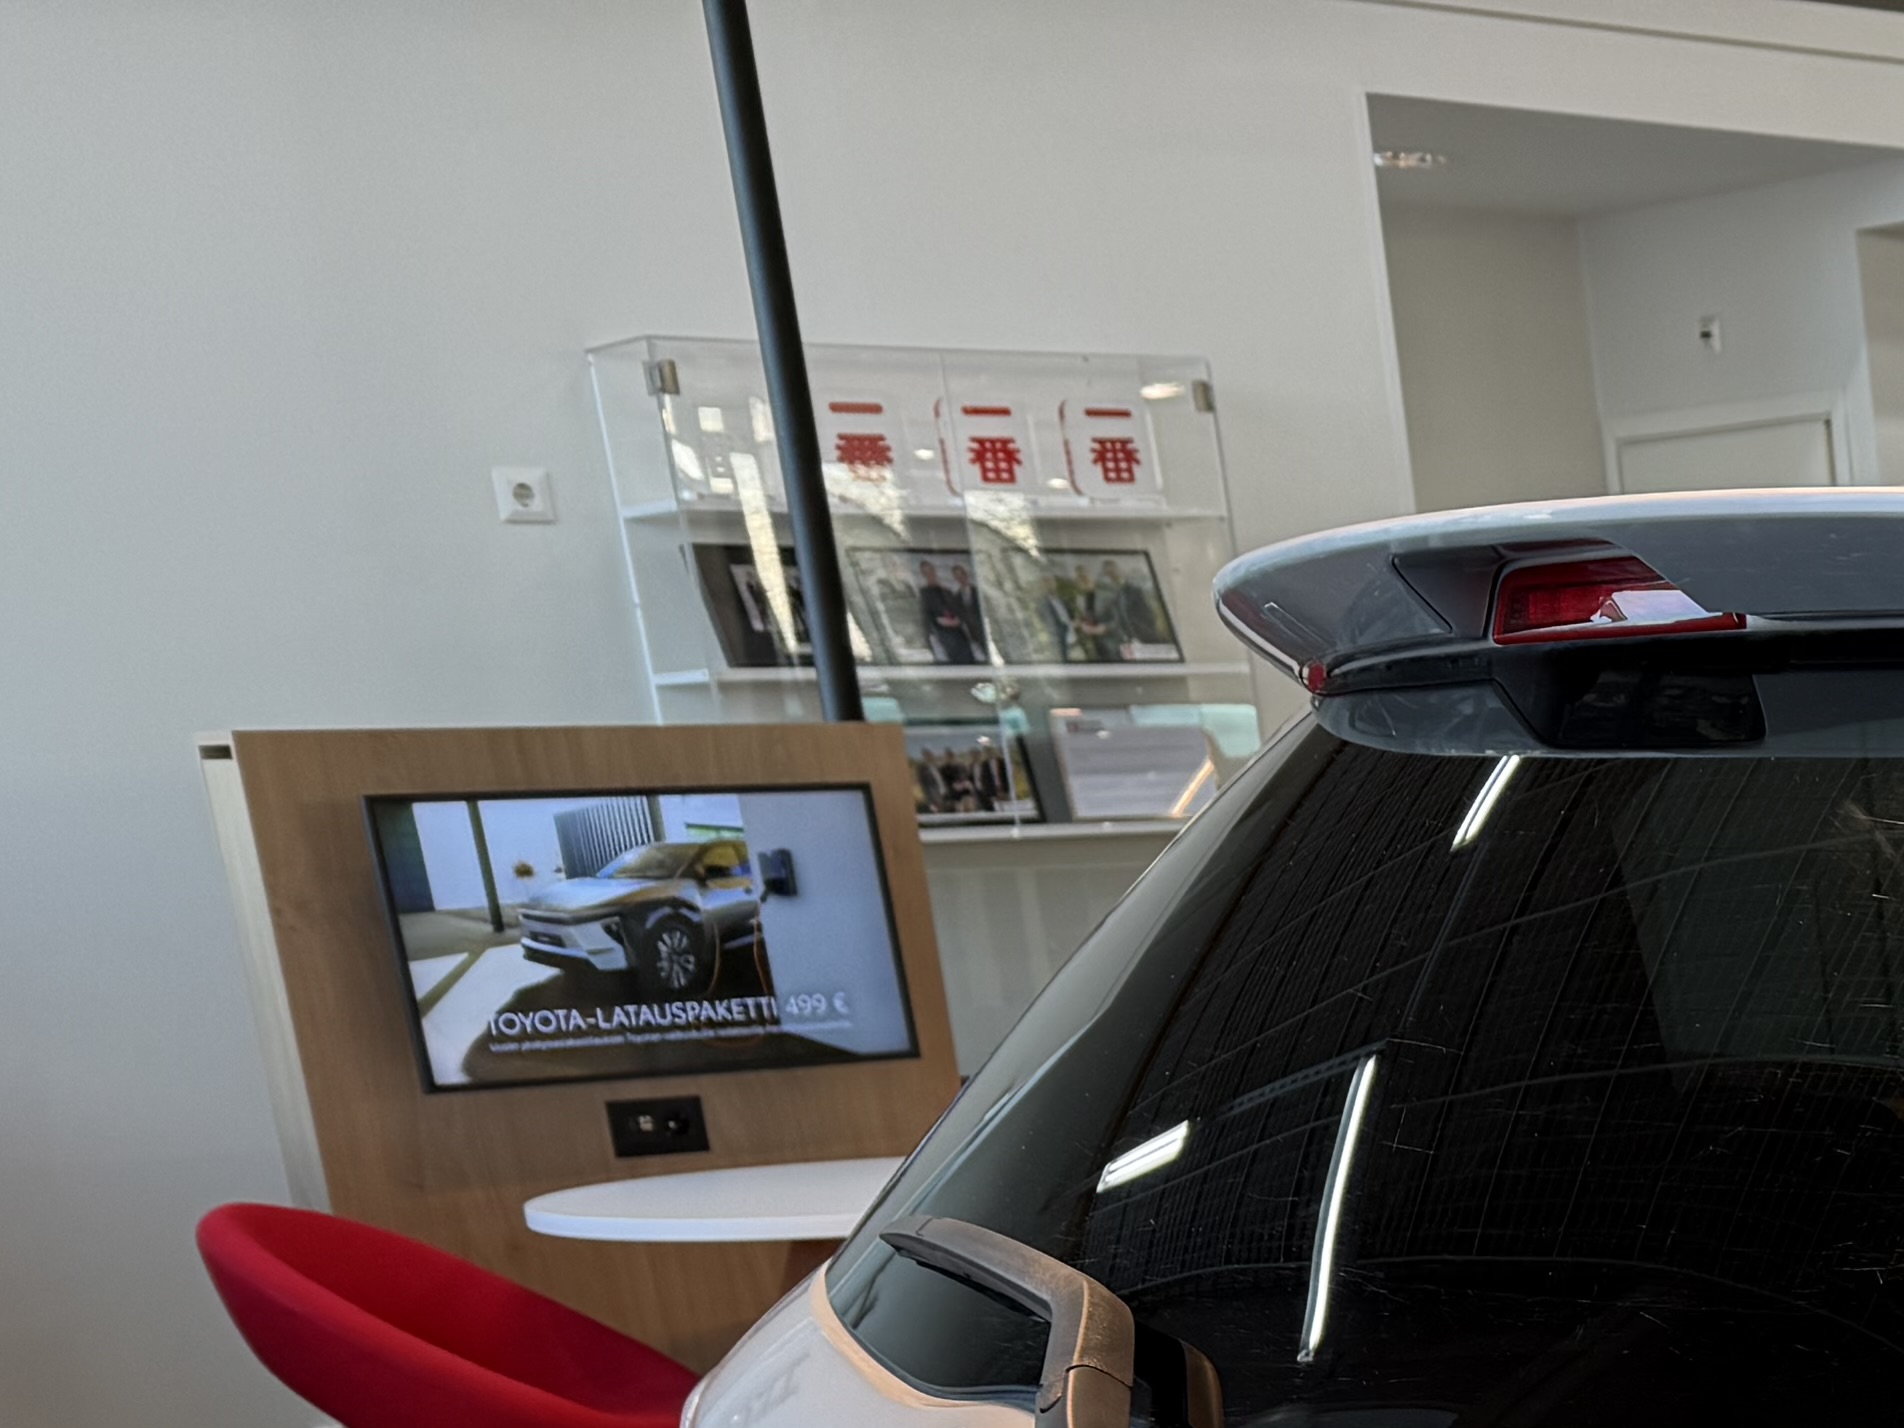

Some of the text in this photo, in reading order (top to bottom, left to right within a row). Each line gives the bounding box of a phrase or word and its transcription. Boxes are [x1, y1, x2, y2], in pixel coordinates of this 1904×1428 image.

[488, 996, 778, 1037] TOYOTA-LATAUSPAKETTI
[784, 992, 827, 1017] 499
[831, 990, 849, 1015] €
